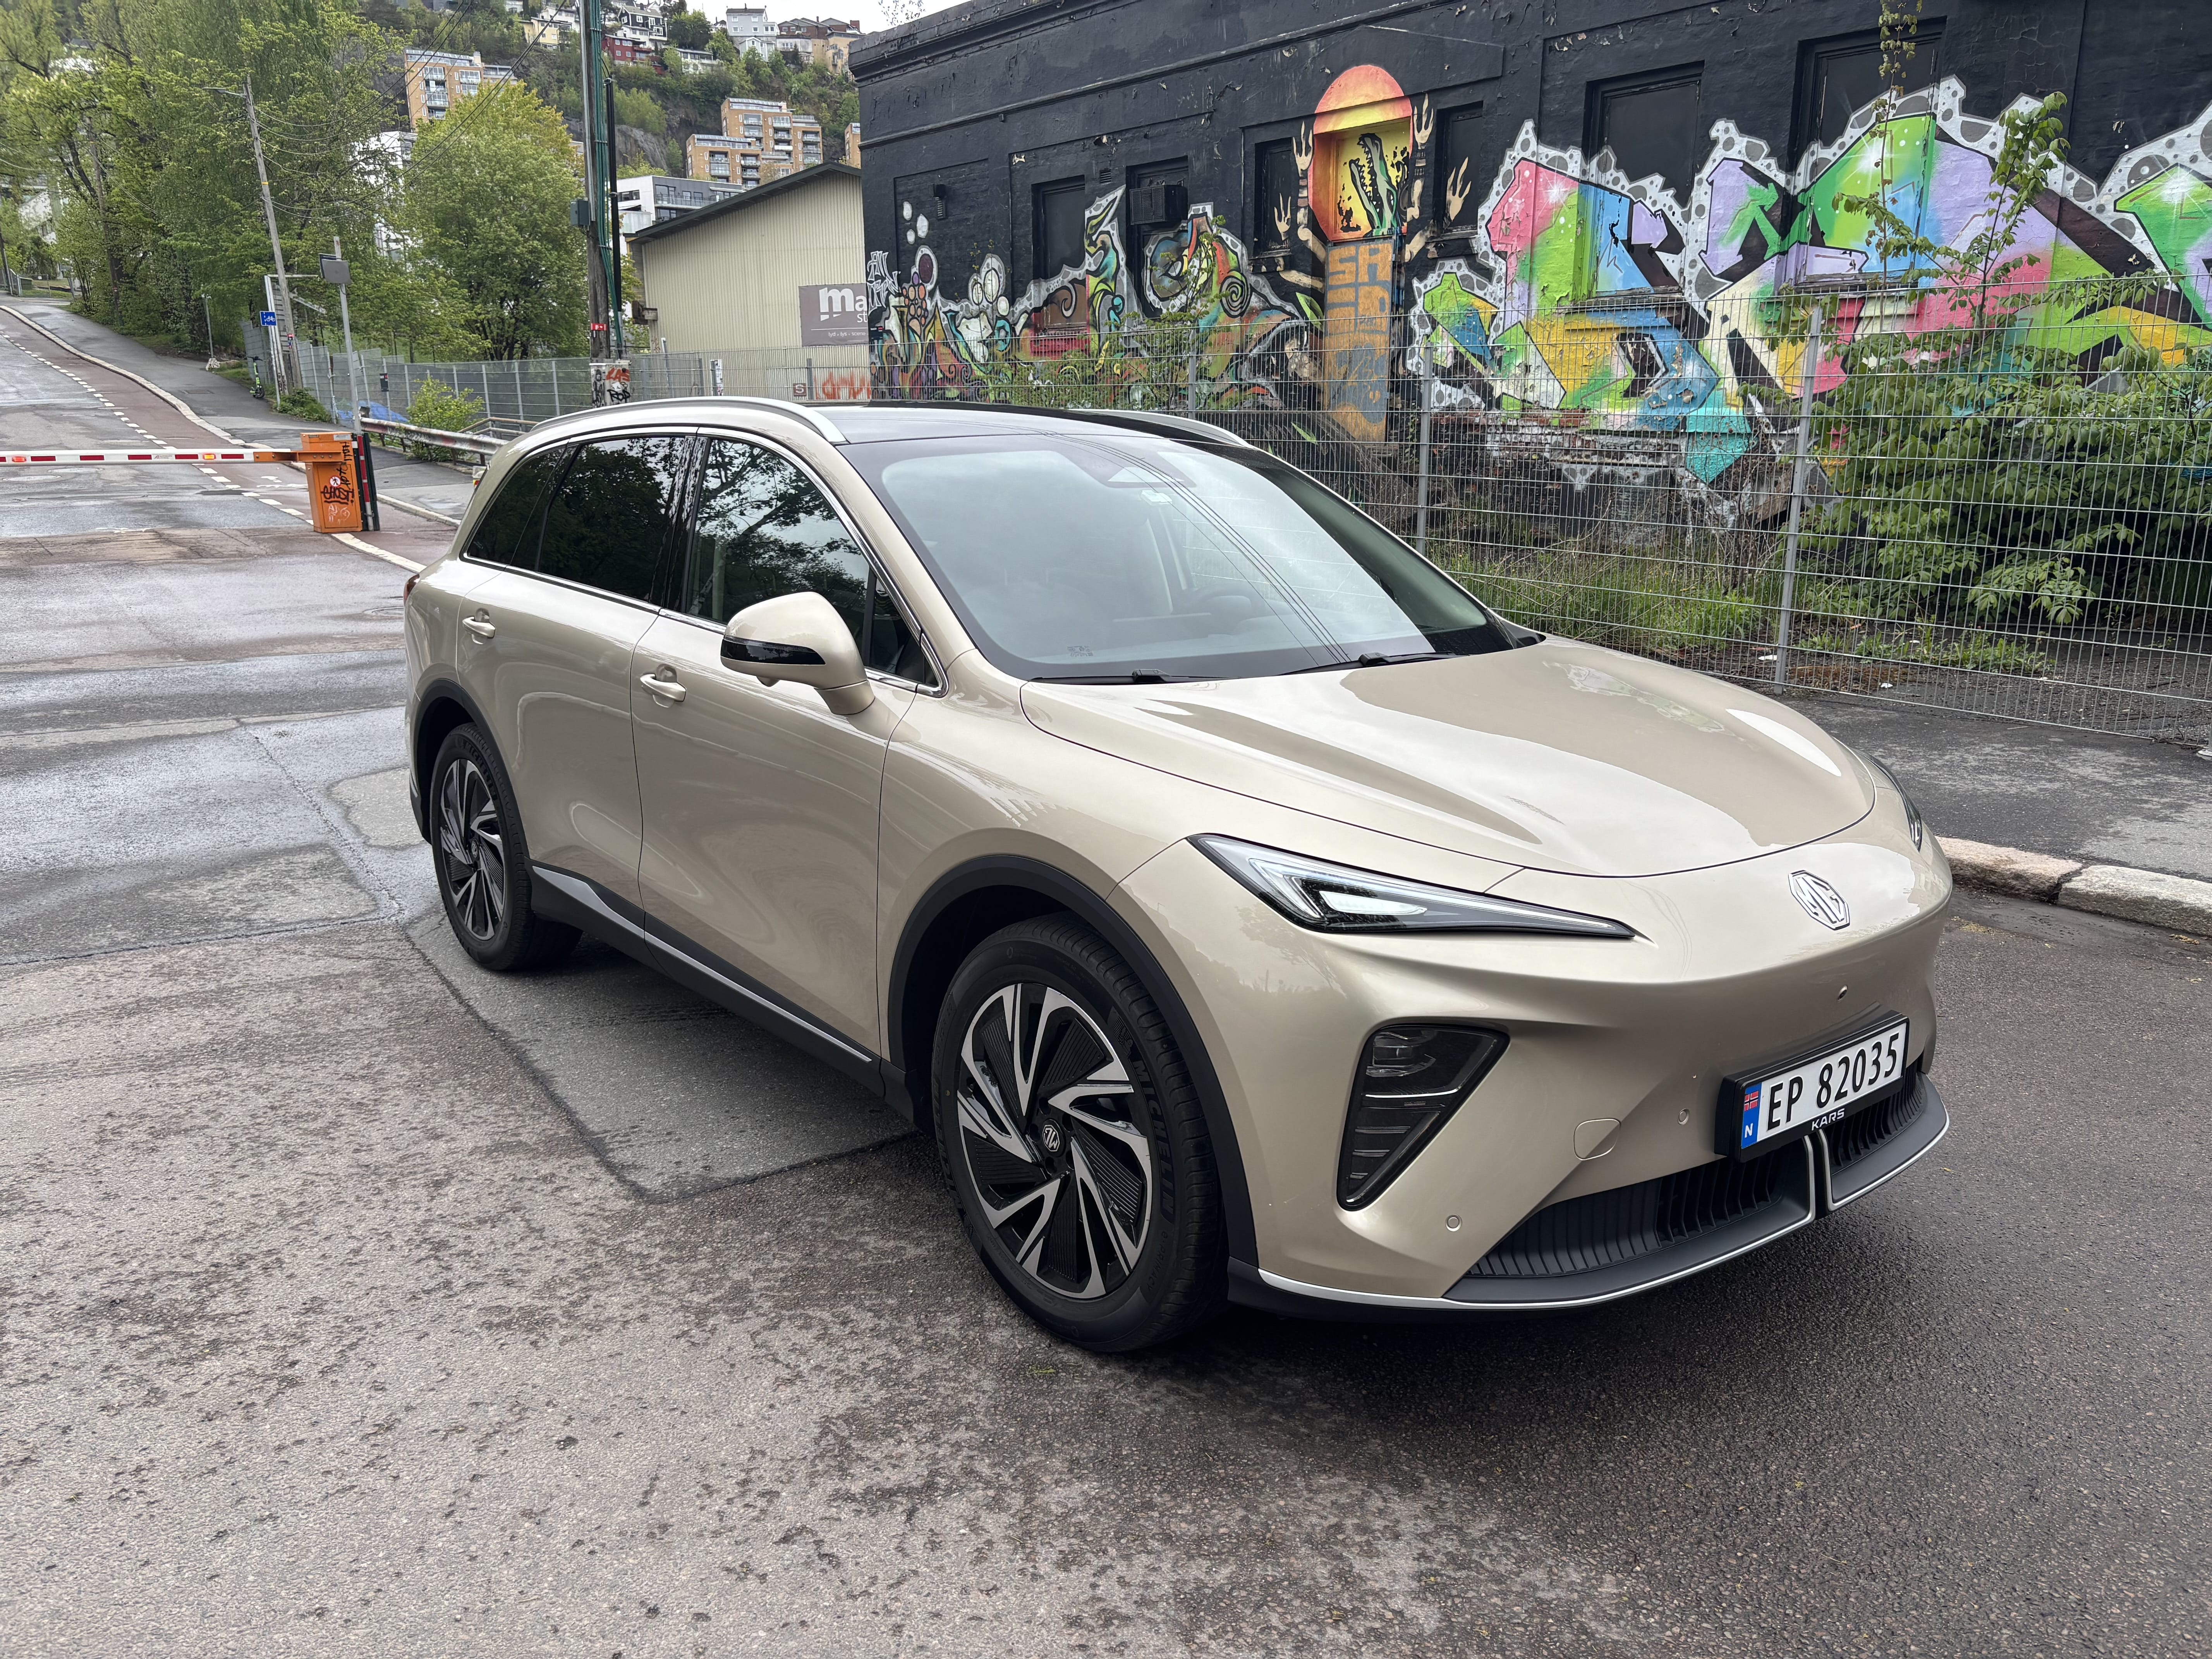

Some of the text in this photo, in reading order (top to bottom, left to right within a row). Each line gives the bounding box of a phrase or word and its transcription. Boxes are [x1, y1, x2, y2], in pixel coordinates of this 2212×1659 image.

[1791, 874, 1846, 926] MG
[1767, 1032, 1899, 1132] EP 82035
[1133, 1060, 1174, 1214] MICHELIN
[1744, 1123, 1753, 1138] N
[1811, 1108, 1845, 1131] KARS
